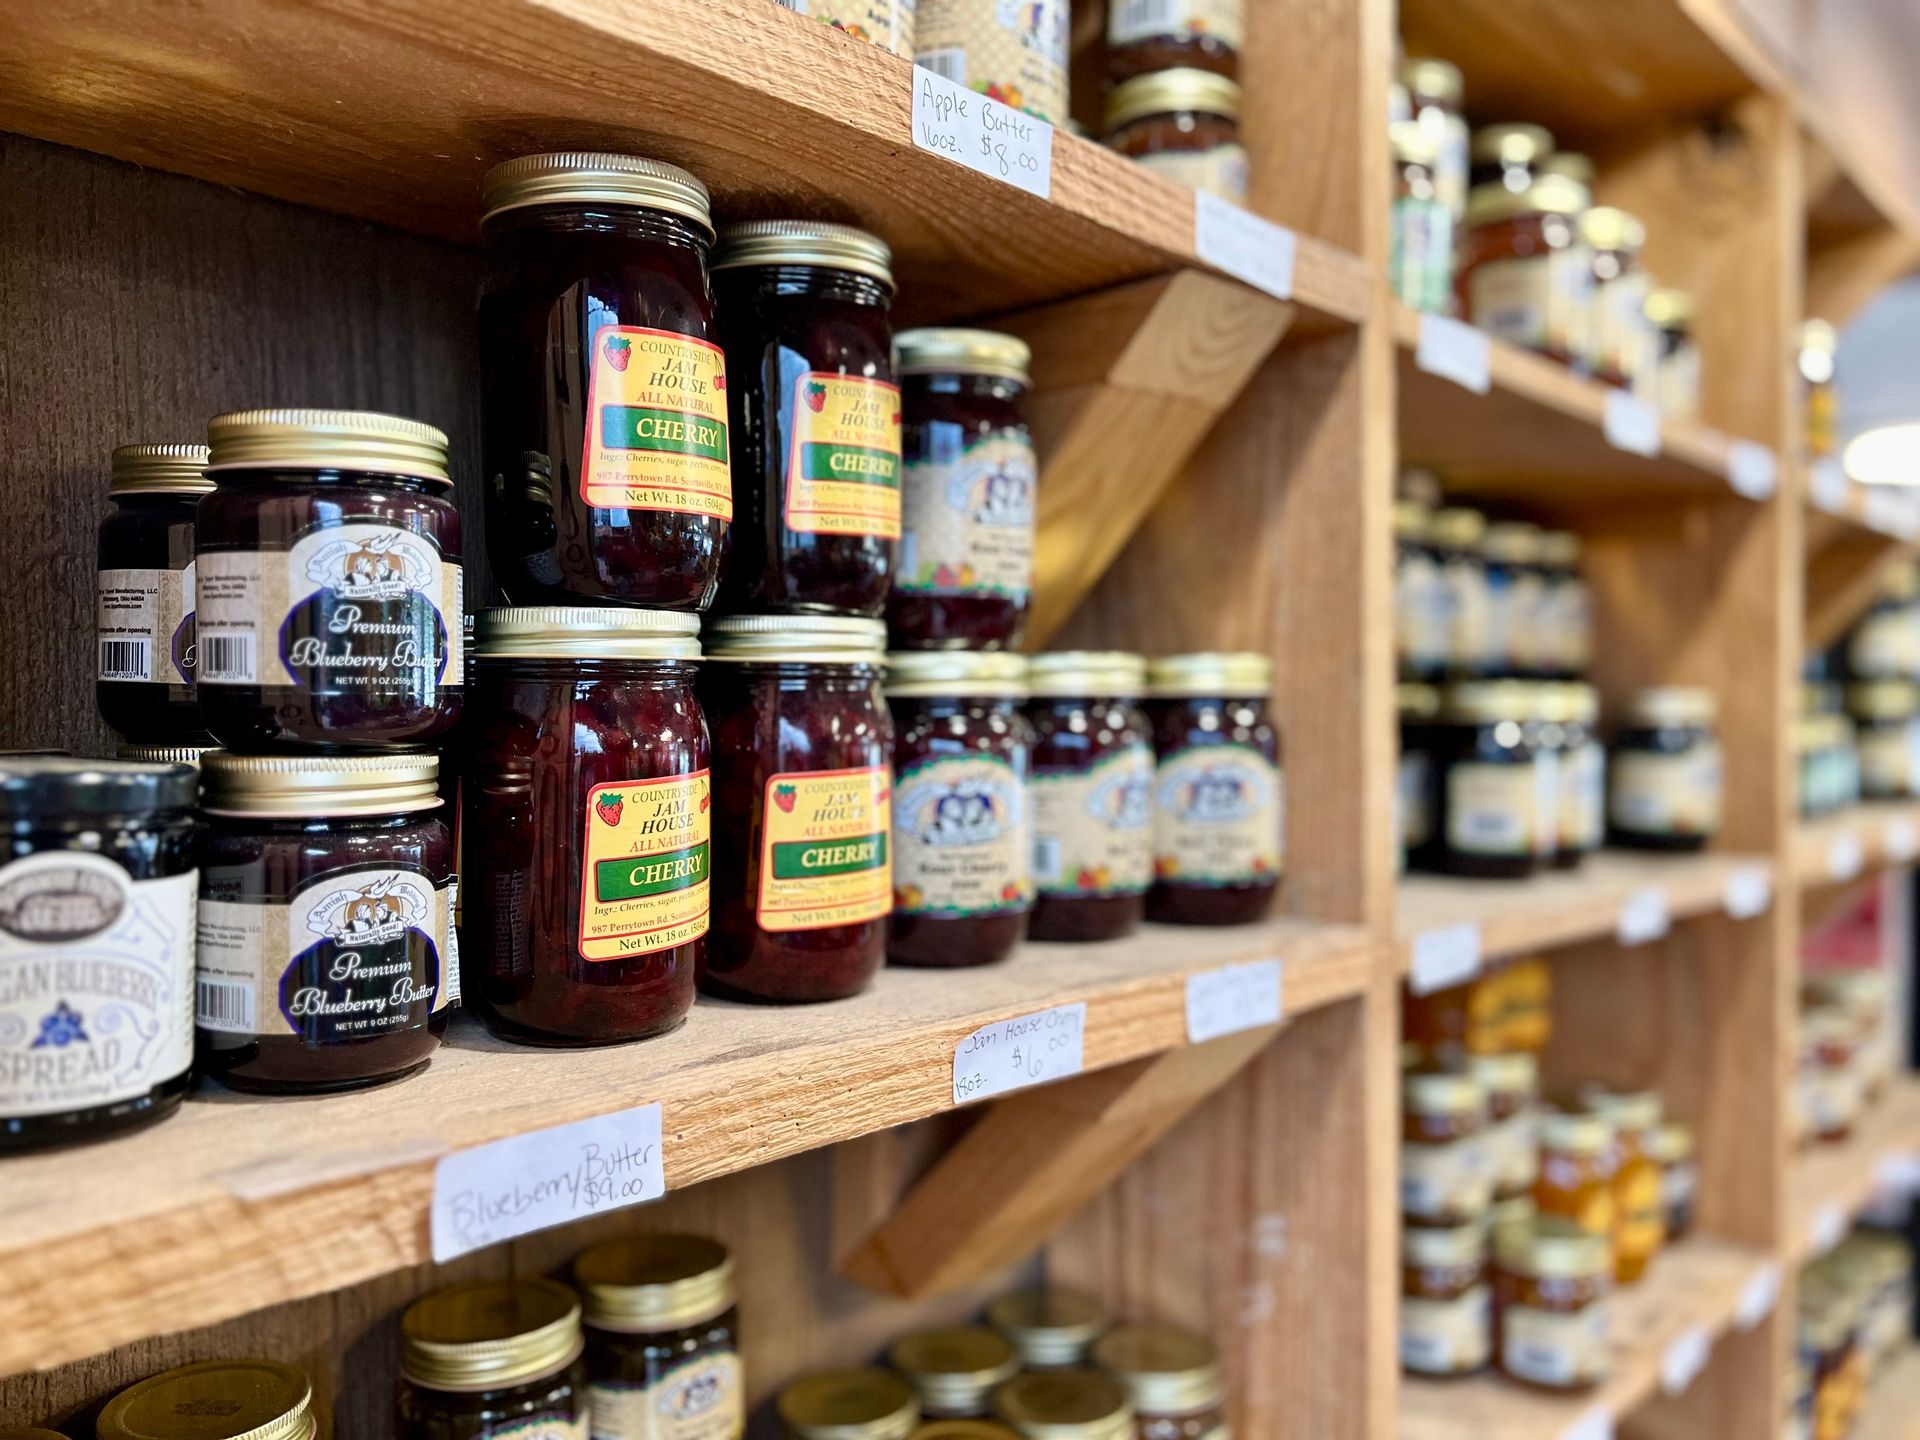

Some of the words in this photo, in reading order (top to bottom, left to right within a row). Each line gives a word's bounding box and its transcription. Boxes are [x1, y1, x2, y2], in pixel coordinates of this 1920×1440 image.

[922, 77, 969, 122] Apple
[982, 102, 1035, 142] Butter
[981, 134, 1039, 176] $8.00
[640, 340, 712, 365] COUNTRYSIDE
[662, 357, 698, 376] JAM
[649, 372, 707, 395] HOUSE
[636, 391, 664, 404] ALL
[666, 394, 714, 414] NATURAL
[636, 418, 718, 447] CHERRY
[626, 453, 664, 465] Cherries,
[616, 472, 663, 484] Perrytown
[625, 490, 648, 501] Net
[652, 491, 672, 504] Wt.
[676, 494, 687, 505] 18
[128, 627, 151, 635] opening
[328, 604, 416, 635] Premium
[289, 637, 388, 672] Blueberry
[391, 639, 443, 669] Butter
[335, 676, 353, 685] NET
[354, 676, 369, 685] WT
[371, 676, 377, 685] 9
[378, 676, 391, 685] OZ
[632, 784, 698, 804] COUNTRYSIDE
[652, 800, 686, 817] JAM
[640, 813, 694, 835] HOUSE
[629, 840, 655, 853] ALL
[657, 830, 700, 849] NATURAL
[802, 841, 878, 868] CHERRY
[629, 853, 703, 886] CHERRY
[619, 902, 656, 912] Cherries,
[657, 897, 677, 907] sugar,
[349, 930, 380, 942] Naturally
[381, 923, 399, 933] Good!
[591, 924, 608, 934] 987
[610, 920, 655, 932] Perrytown
[619, 939, 643, 951] Net
[644, 934, 663, 945] Wt.
[666, 930, 676, 942] 18
[678, 929, 690, 938] oz.
[226, 970, 254, 979] opening
[329, 952, 412, 981] Premium
[55, 960, 159, 1012] BLUEBERRY
[289, 986, 387, 1016] Blueberry
[389, 976, 436, 1007] Butter
[335, 1021, 353, 1031] NET
[354, 1020, 368, 1029] WT
[377, 1018, 388, 1026] OZ
[389, 1014, 409, 1026] (255g)
[1005, 1017, 1042, 1041] House
[1011, 1033, 1070, 1078] $6.00
[582, 1141, 653, 1182] Butter
[583, 1177, 644, 1210] $9.00
